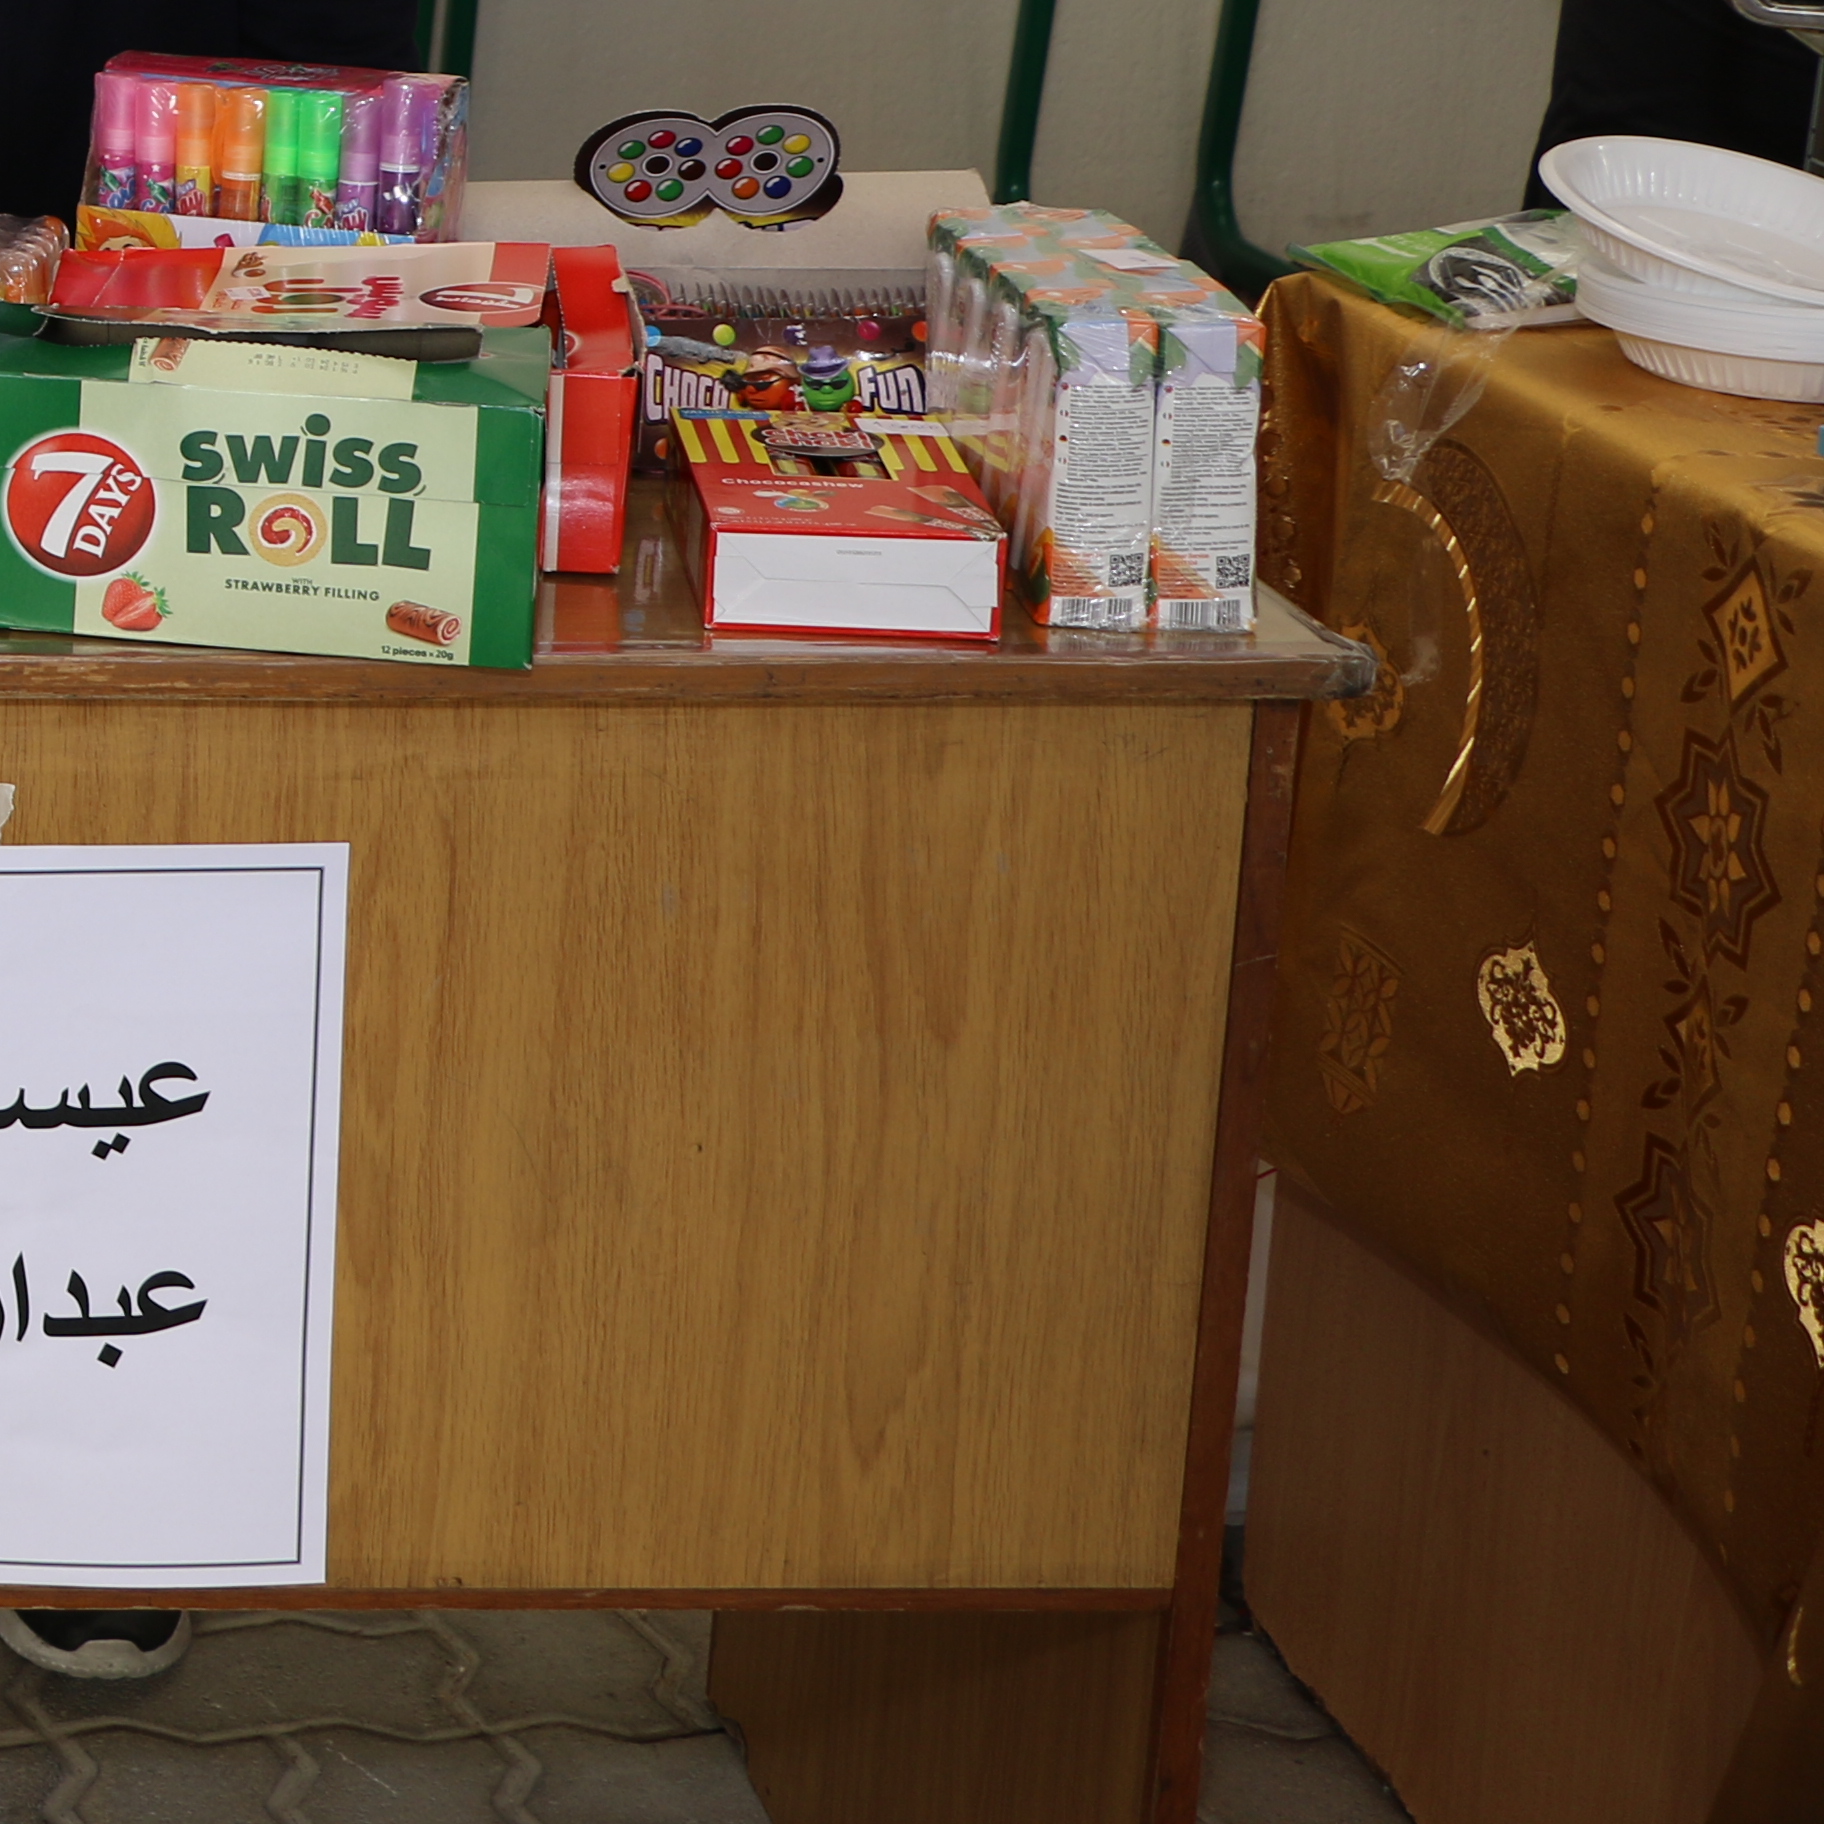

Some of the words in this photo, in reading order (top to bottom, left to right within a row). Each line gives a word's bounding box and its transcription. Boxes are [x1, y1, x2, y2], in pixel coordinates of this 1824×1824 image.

[720, 476, 864, 489] Chococashew
[30, 450, 115, 560] 7
[72, 462, 144, 560] DAYS
[224, 578, 320, 597] STRAWBERRY
[323, 586, 380, 602] FILLING
[381, 644, 392, 655] 12
[392, 645, 427, 659] pieces
[435, 649, 454, 661] 20g
